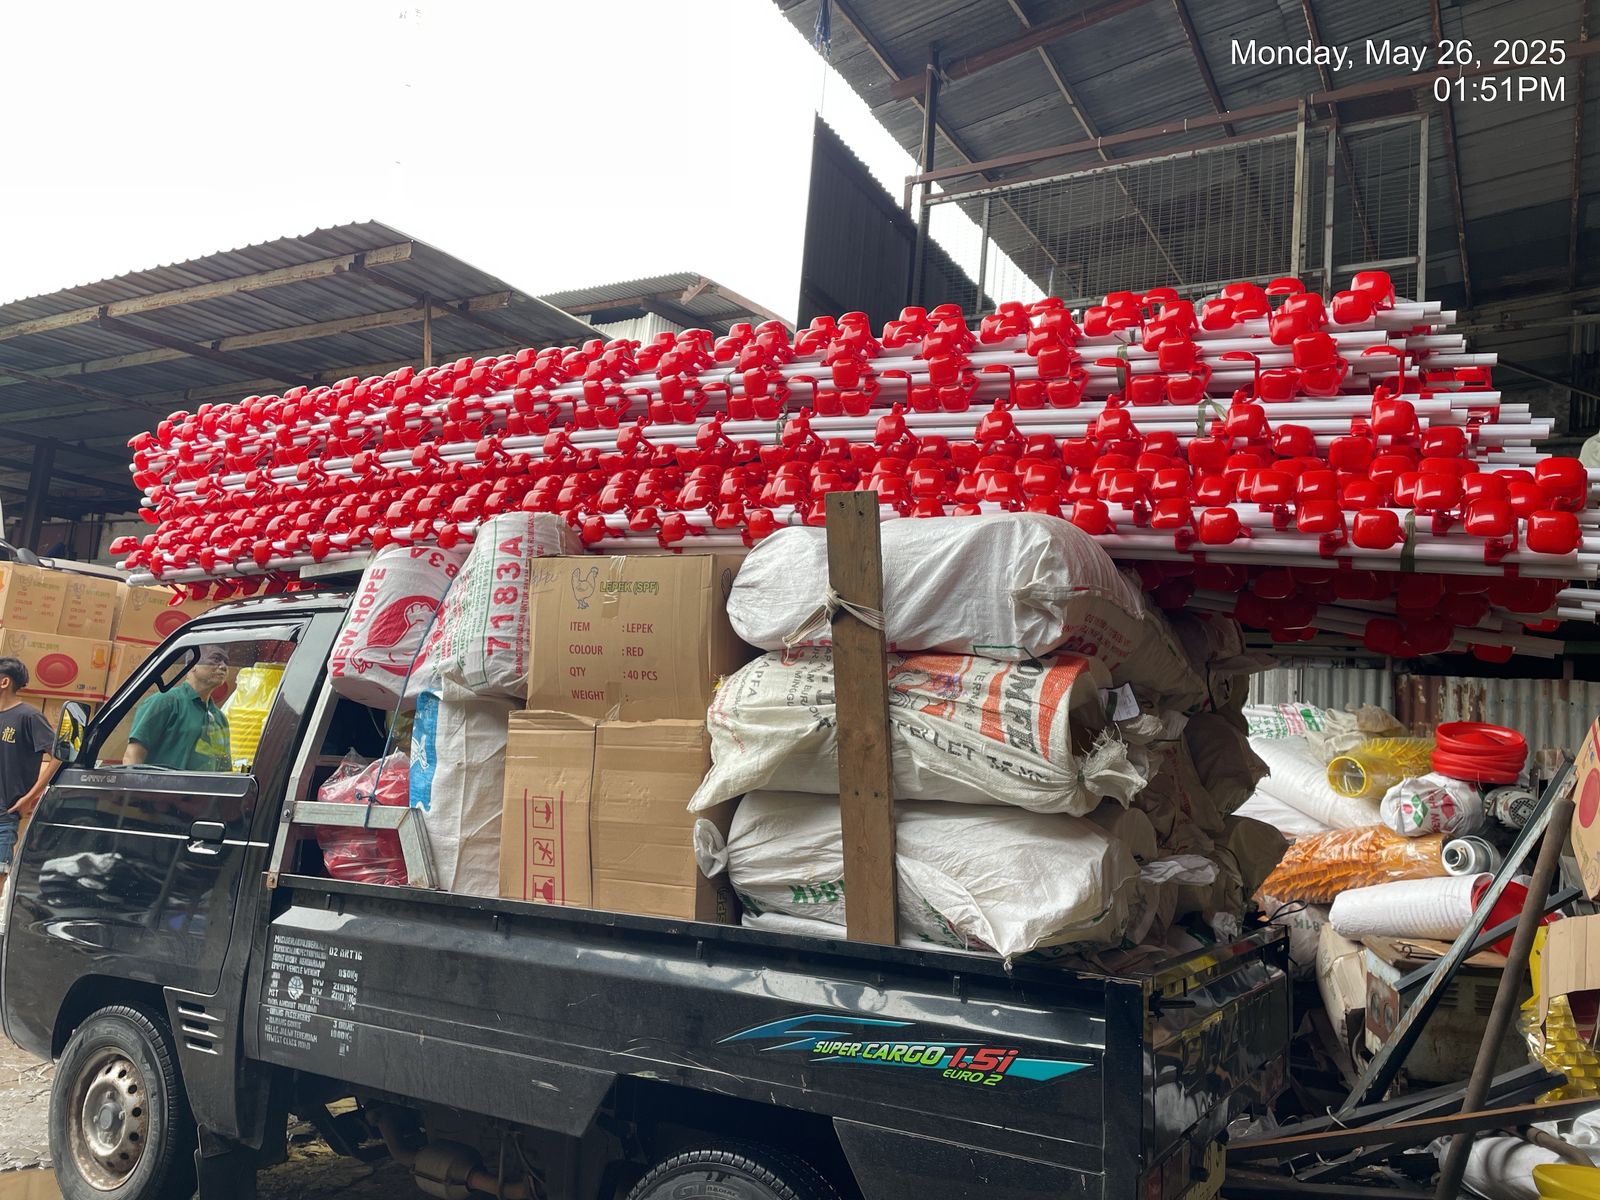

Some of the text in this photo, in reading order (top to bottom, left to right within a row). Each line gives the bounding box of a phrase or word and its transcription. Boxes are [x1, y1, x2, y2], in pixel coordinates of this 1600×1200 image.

[600, 581, 659, 595] LEPEK (SPF)
[486, 536, 523, 656] 7183A
[333, 568, 387, 677] NEW HOPE
[570, 621, 590, 632] ITEM
[569, 645, 603, 655] COLOUR
[569, 667, 586, 678] QTY
[641, 670, 658, 681] PCS
[571, 690, 605, 701] WEIGHT
[814, 1041, 862, 1057] SUPER
[861, 1044, 945, 1065] CARGO
[943, 1068, 1003, 1087] EURO 2
